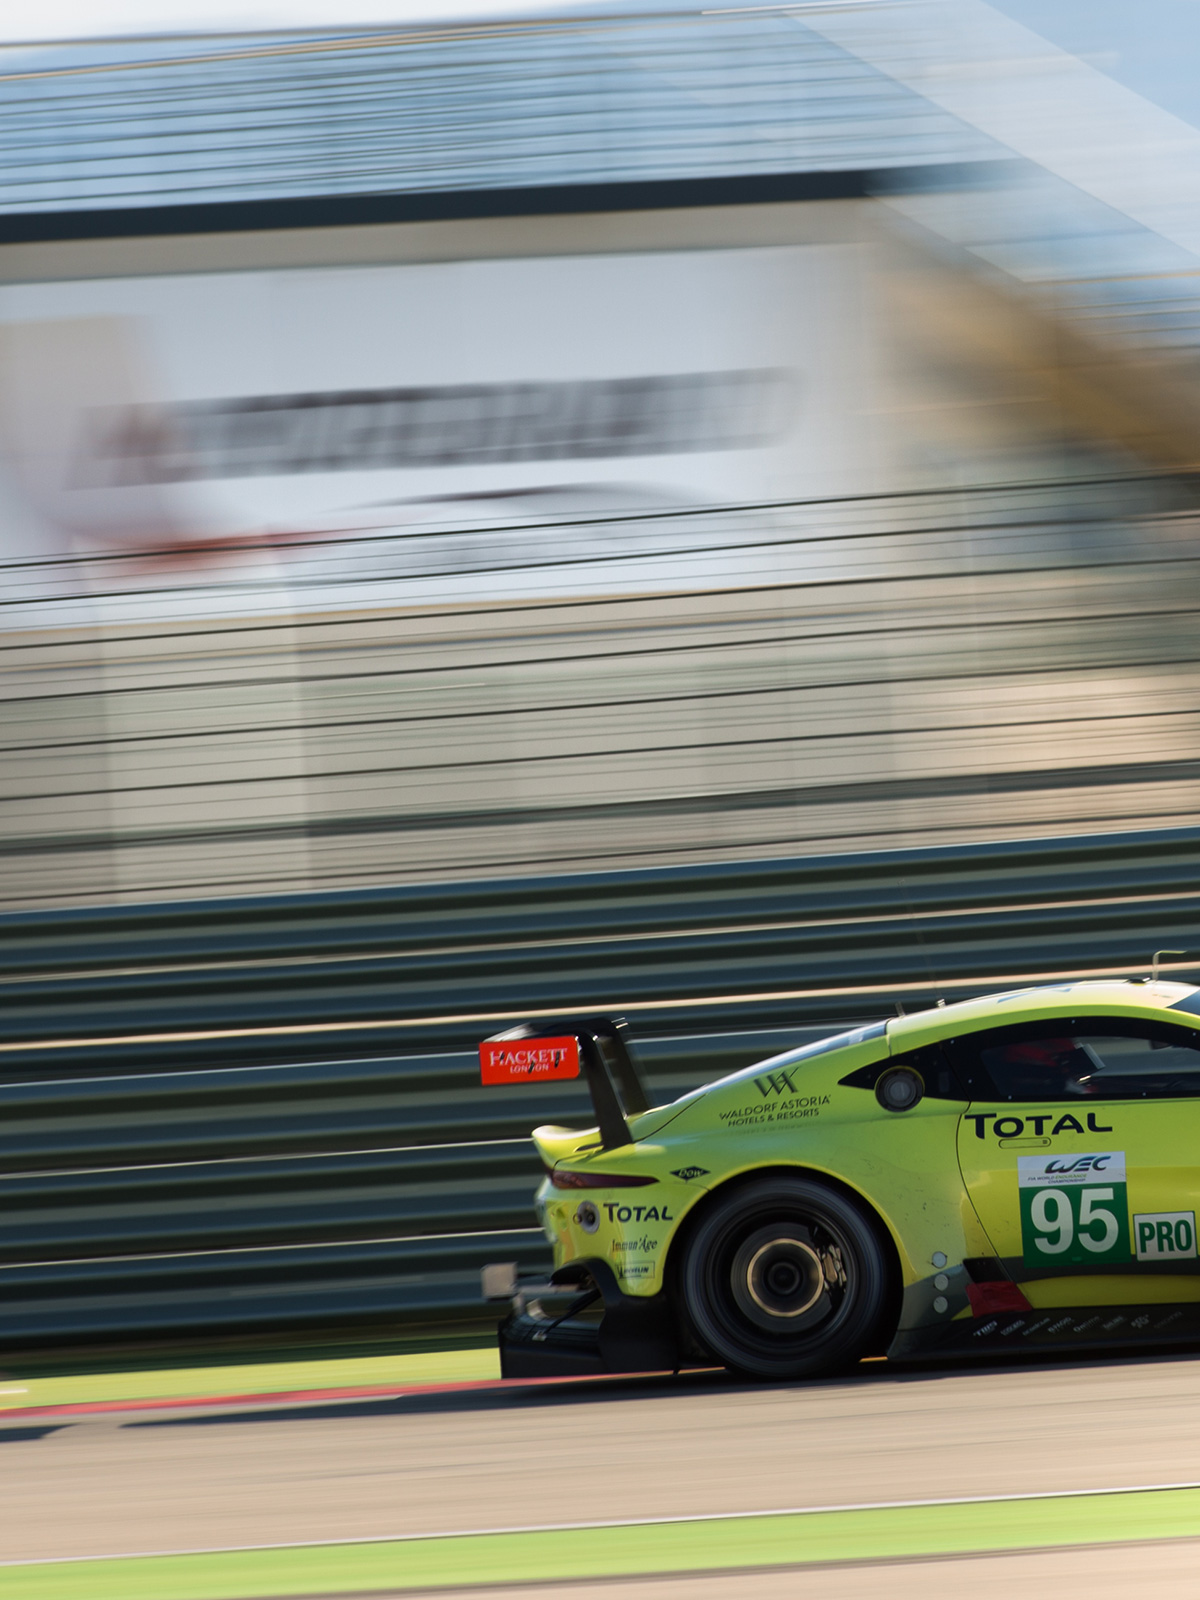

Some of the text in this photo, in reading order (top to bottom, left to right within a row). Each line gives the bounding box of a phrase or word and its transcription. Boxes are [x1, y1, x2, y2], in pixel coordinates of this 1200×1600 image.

[489, 1048, 568, 1067] HACKETT
[510, 1063, 549, 1074] LONON
[719, 1095, 831, 1121] WALDORF ASTORIA
[728, 1107, 819, 1127] HOTELS & RESORTS
[964, 1112, 1113, 1140] TOTAL
[1044, 1155, 1111, 1174] WEC
[603, 1202, 673, 1223] TOTAL
[1031, 1187, 1119, 1254] 95
[1138, 1219, 1193, 1254] PRO
